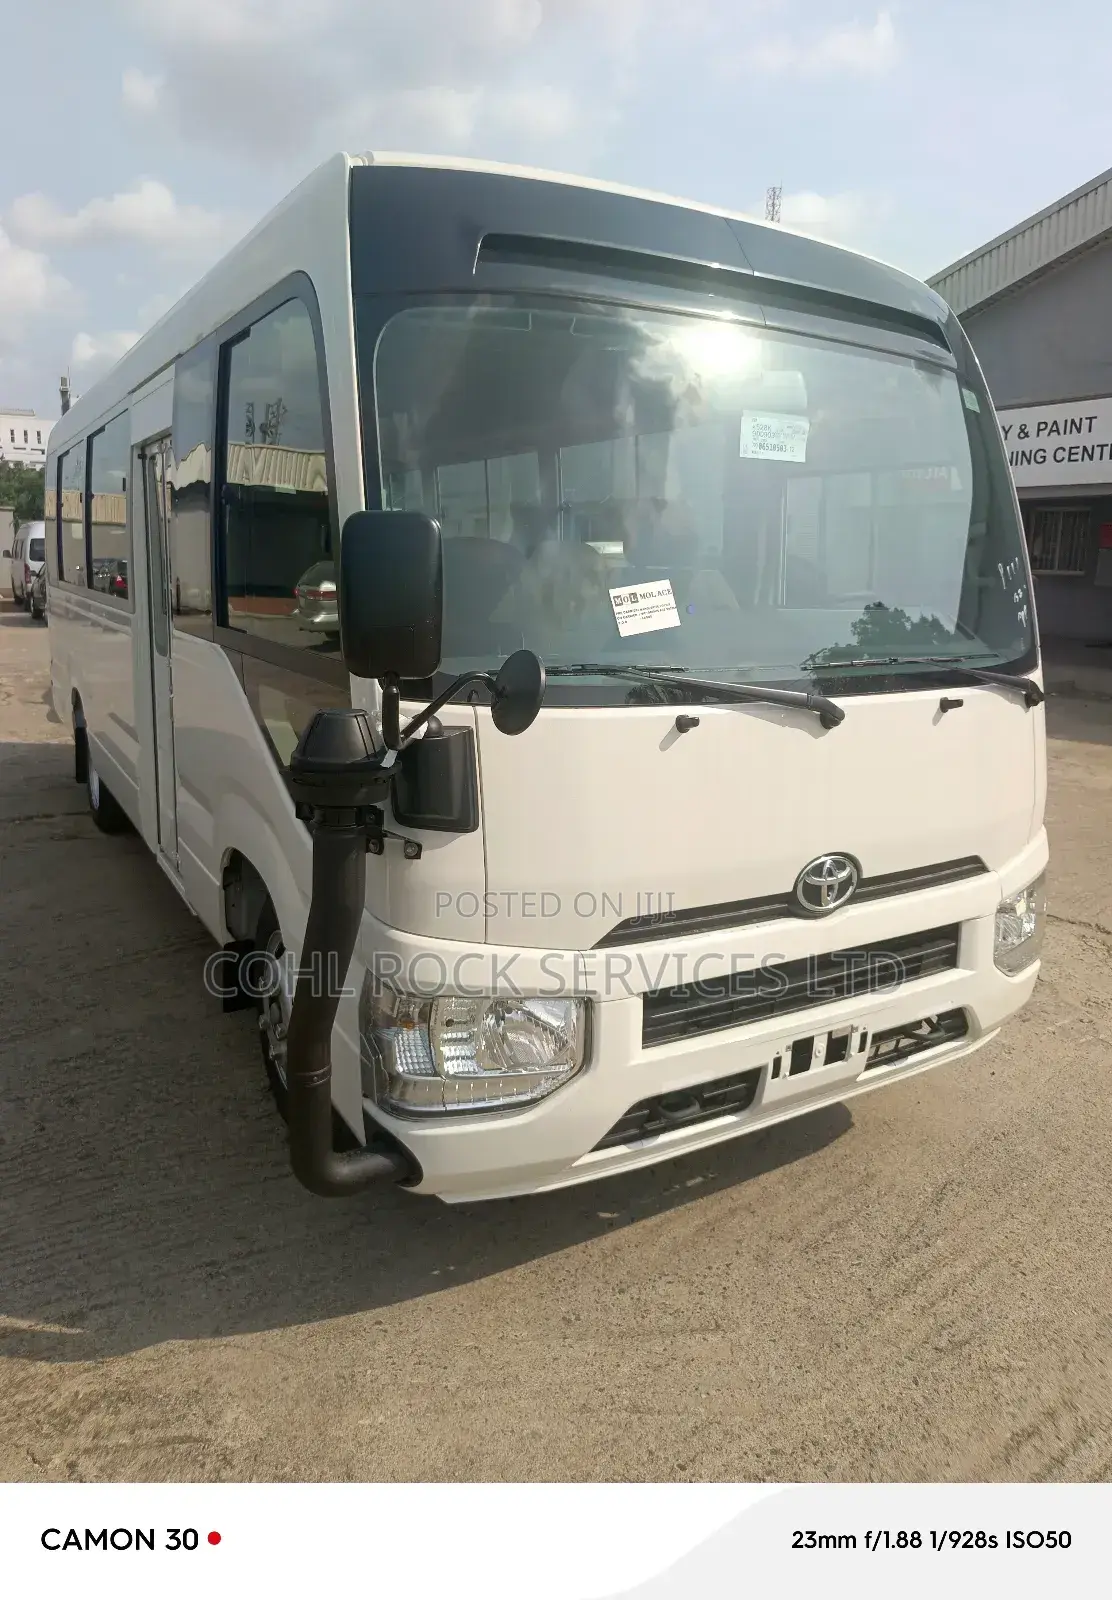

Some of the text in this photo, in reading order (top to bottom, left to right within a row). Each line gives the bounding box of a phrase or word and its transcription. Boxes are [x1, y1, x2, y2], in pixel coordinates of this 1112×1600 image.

[1017, 424, 1030, 440] &
[1036, 416, 1098, 438] PAINT
[1053, 443, 1112, 463] CENT
[613, 592, 639, 607] MOL
[639, 591, 656, 600] MOL
